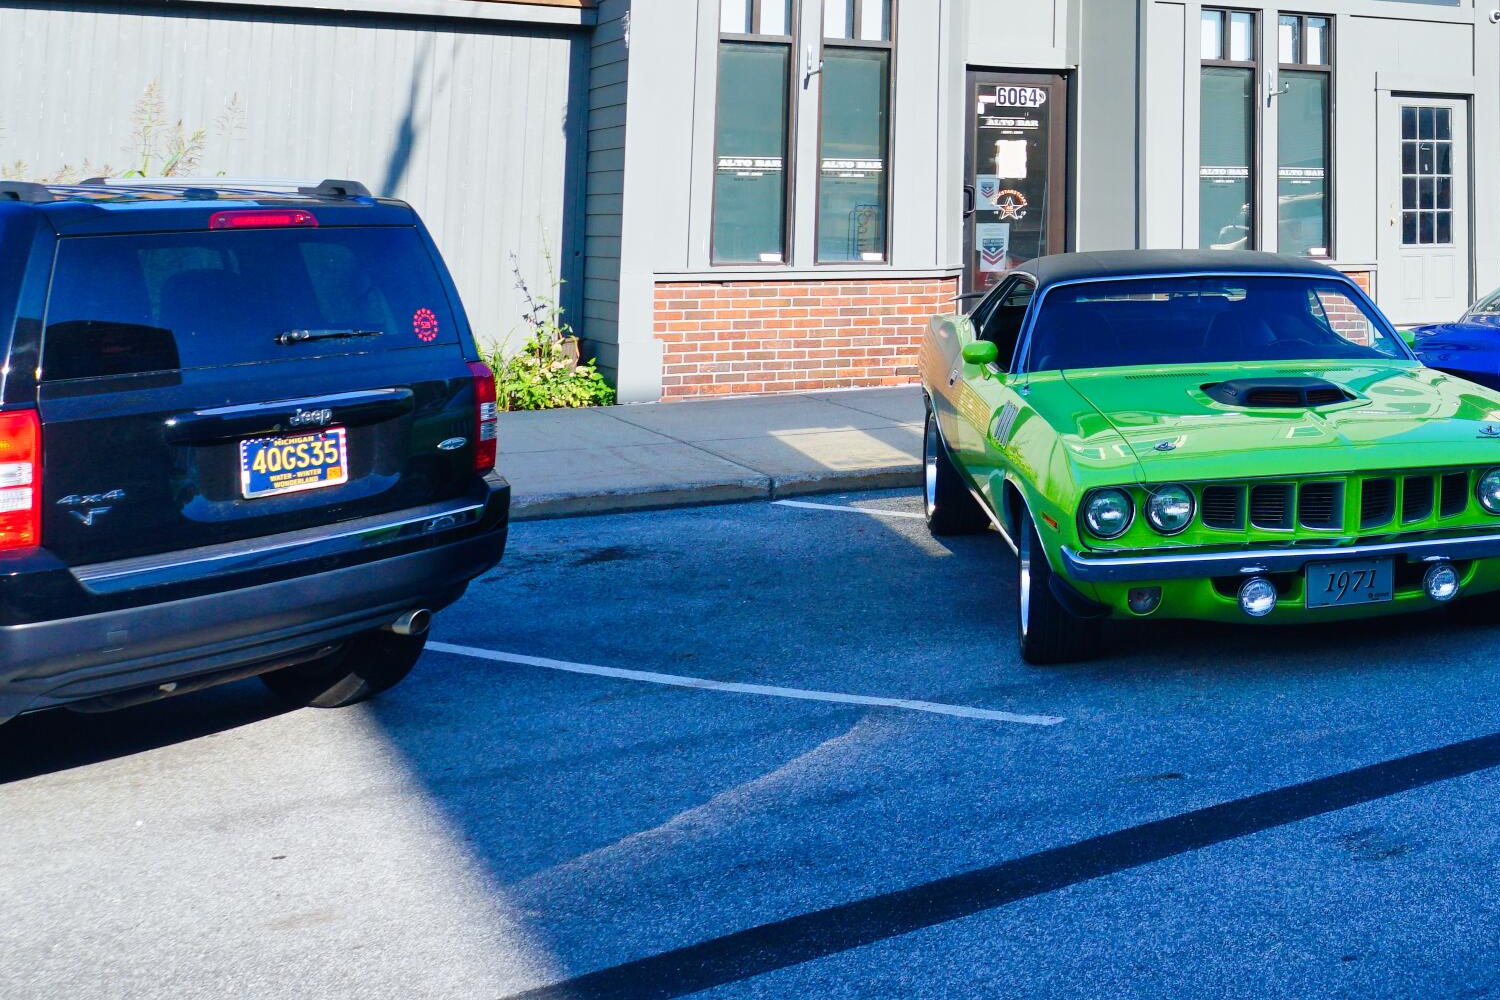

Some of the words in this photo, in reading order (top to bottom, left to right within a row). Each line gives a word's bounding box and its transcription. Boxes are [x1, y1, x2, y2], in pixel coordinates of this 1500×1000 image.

[997, 87, 1038, 106] 6064
[718, 159, 752, 167] ALTO
[755, 159, 782, 167] BAR
[822, 160, 854, 168] ALTO
[856, 161, 882, 169] BAR
[1200, 168, 1226, 176] ALTO
[289, 408, 332, 426] Jeep
[274, 436, 314, 446] MICHIGAN
[273, 476, 318, 488] WONDERLAND
[1324, 568, 1377, 601] 1971
